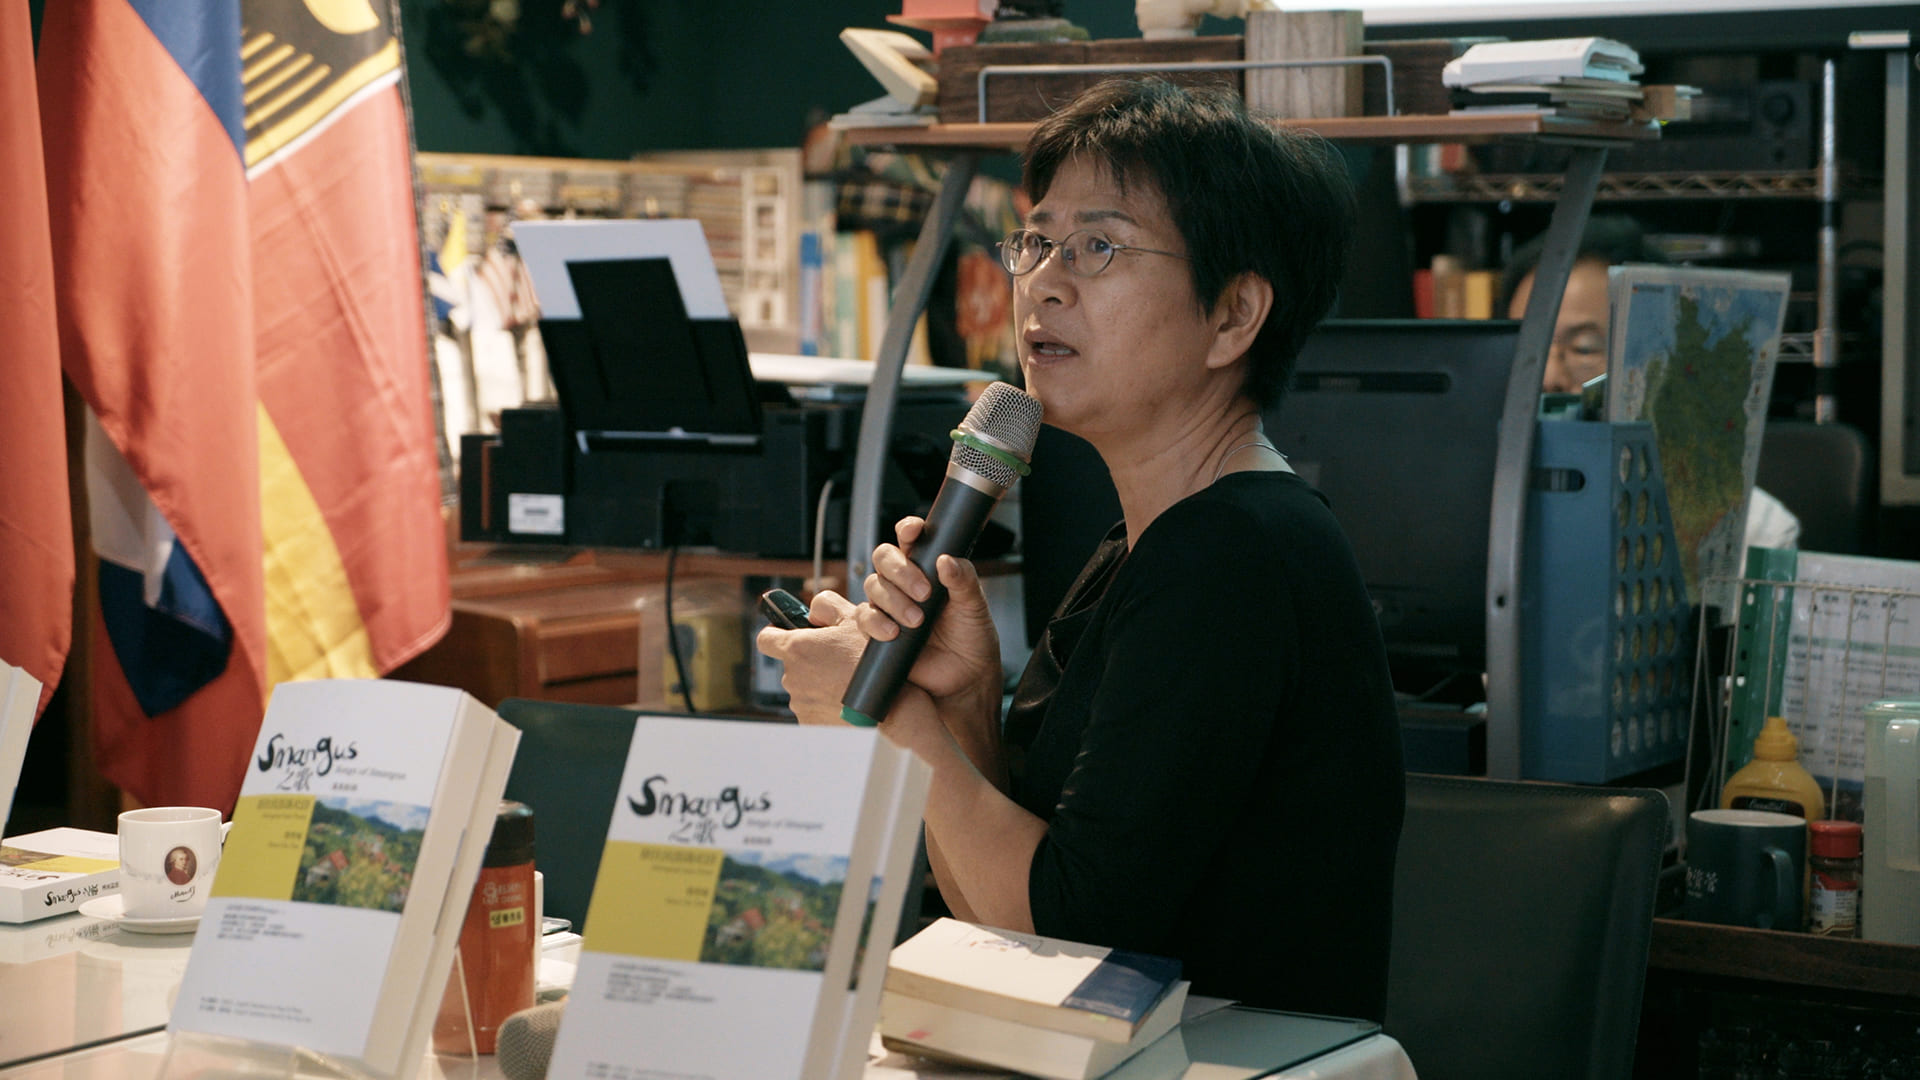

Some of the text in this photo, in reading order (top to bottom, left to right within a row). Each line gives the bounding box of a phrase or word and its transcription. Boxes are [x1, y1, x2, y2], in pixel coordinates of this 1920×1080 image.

[257, 733, 359, 776] Smangus
[276, 767, 314, 791] 之歌
[627, 774, 772, 829] Smangus
[668, 817, 717, 844] 之歌
